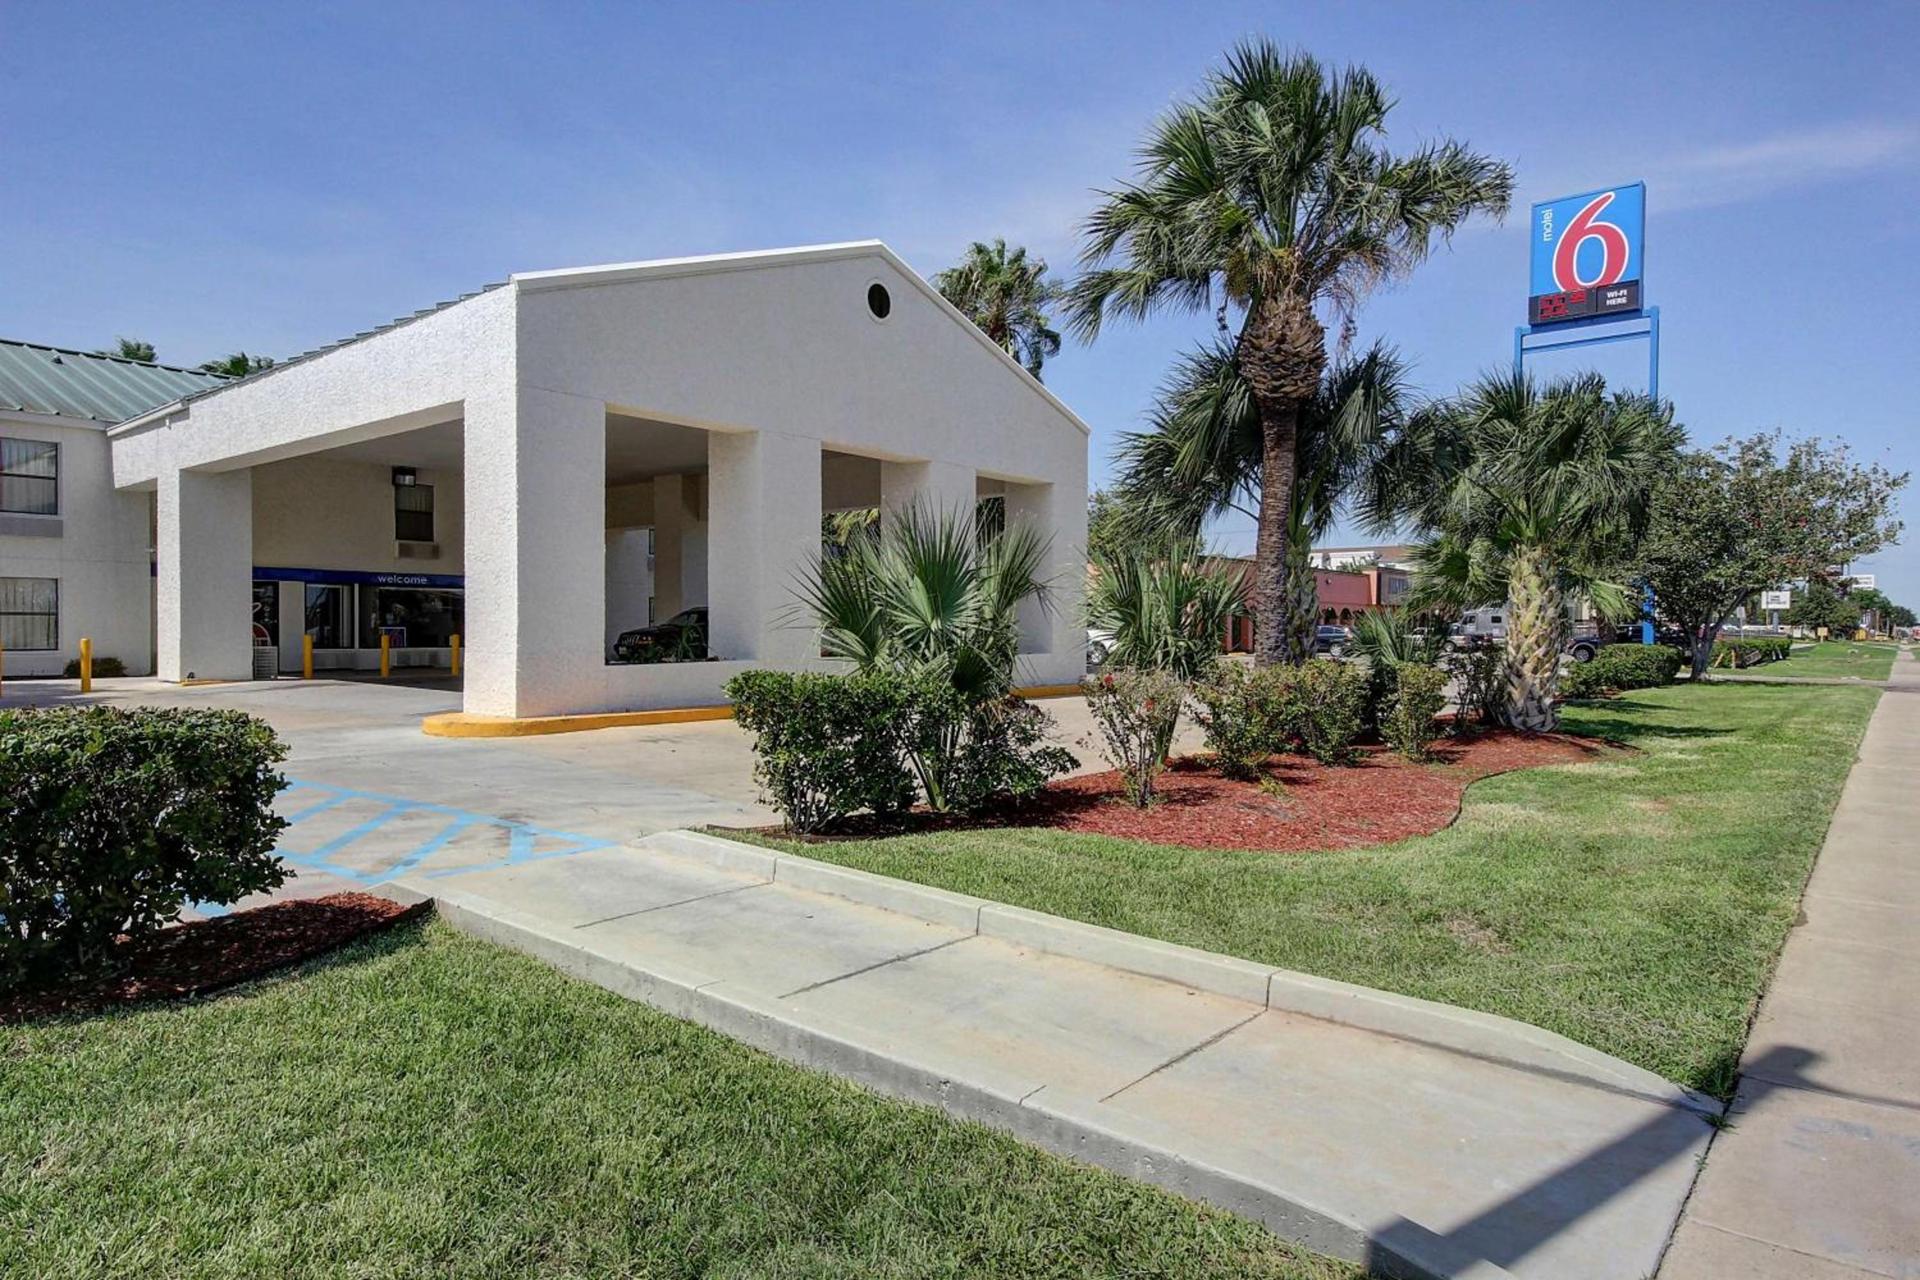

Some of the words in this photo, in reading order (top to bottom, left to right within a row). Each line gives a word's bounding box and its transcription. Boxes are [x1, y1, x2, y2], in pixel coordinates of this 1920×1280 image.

[1541, 209, 1553, 242] motel
[1553, 192, 1630, 292] 6
[1606, 297, 1627, 306] HERE
[377, 575, 428, 585] welcome
